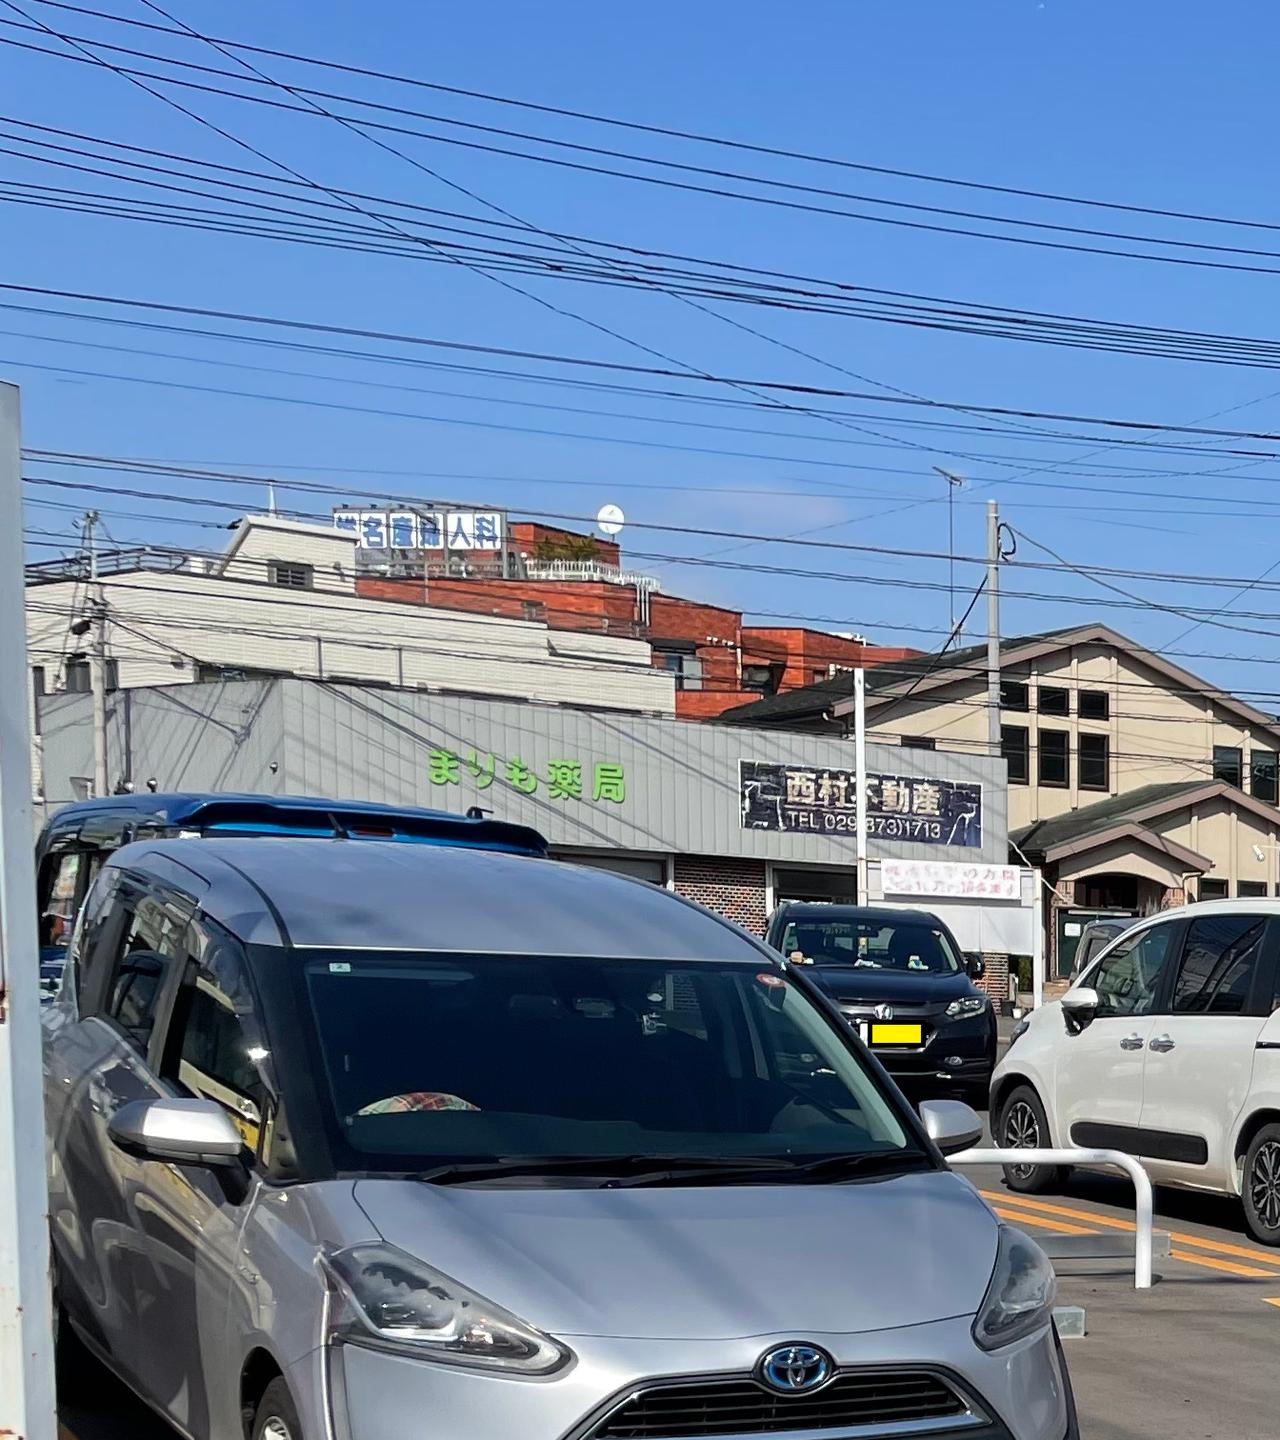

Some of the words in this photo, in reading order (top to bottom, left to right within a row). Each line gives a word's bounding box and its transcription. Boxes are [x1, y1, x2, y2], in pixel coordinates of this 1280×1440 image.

[429, 749, 625, 803] まりも薬局
[786, 811, 820, 829] TEL
